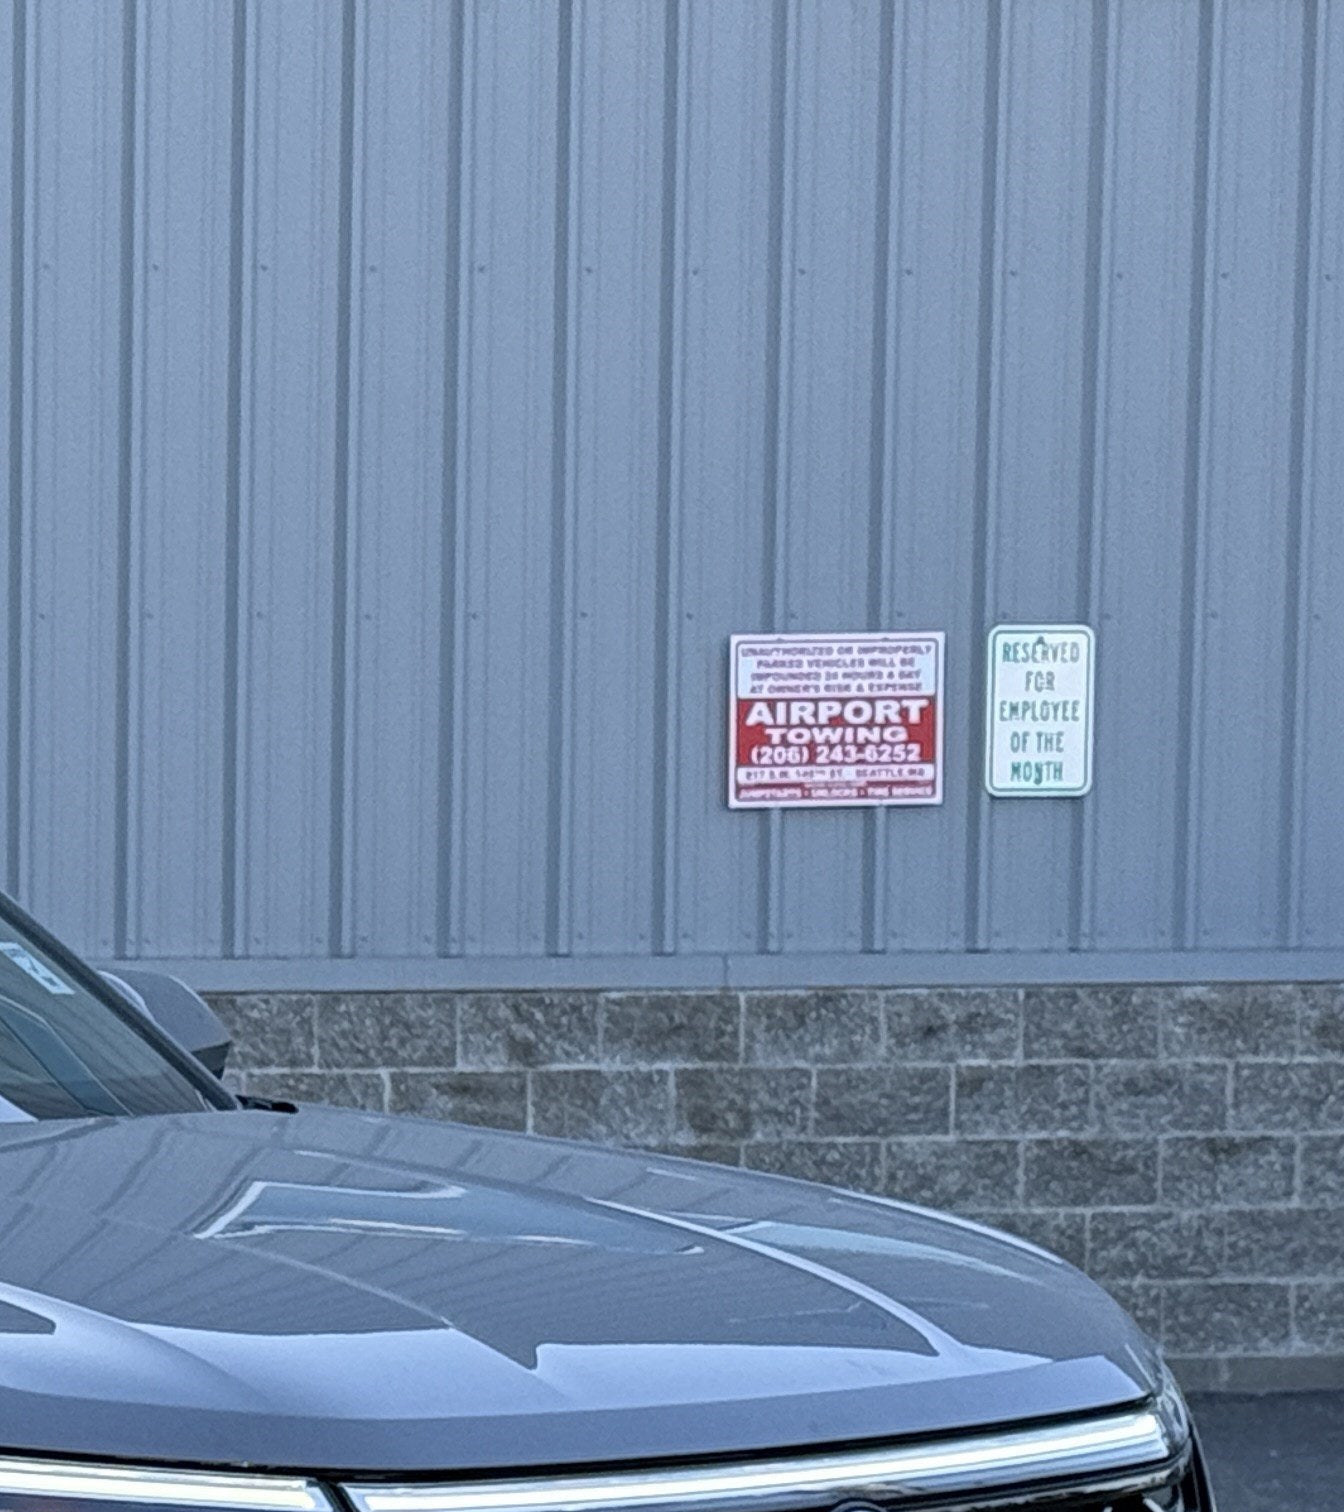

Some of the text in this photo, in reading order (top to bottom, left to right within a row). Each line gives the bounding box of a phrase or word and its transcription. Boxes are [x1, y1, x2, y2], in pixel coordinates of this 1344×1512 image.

[1002, 640, 1080, 664] RESERVED
[1024, 670, 1056, 692] FOR
[745, 699, 930, 727] AIRPORT
[999, 699, 1080, 723] EMPLOYEE
[765, 726, 909, 745] TOWING
[1010, 731, 1065, 754] OF THE
[750, 743, 922, 765] (206) 243-6252
[1010, 760, 1064, 786] MONTH
